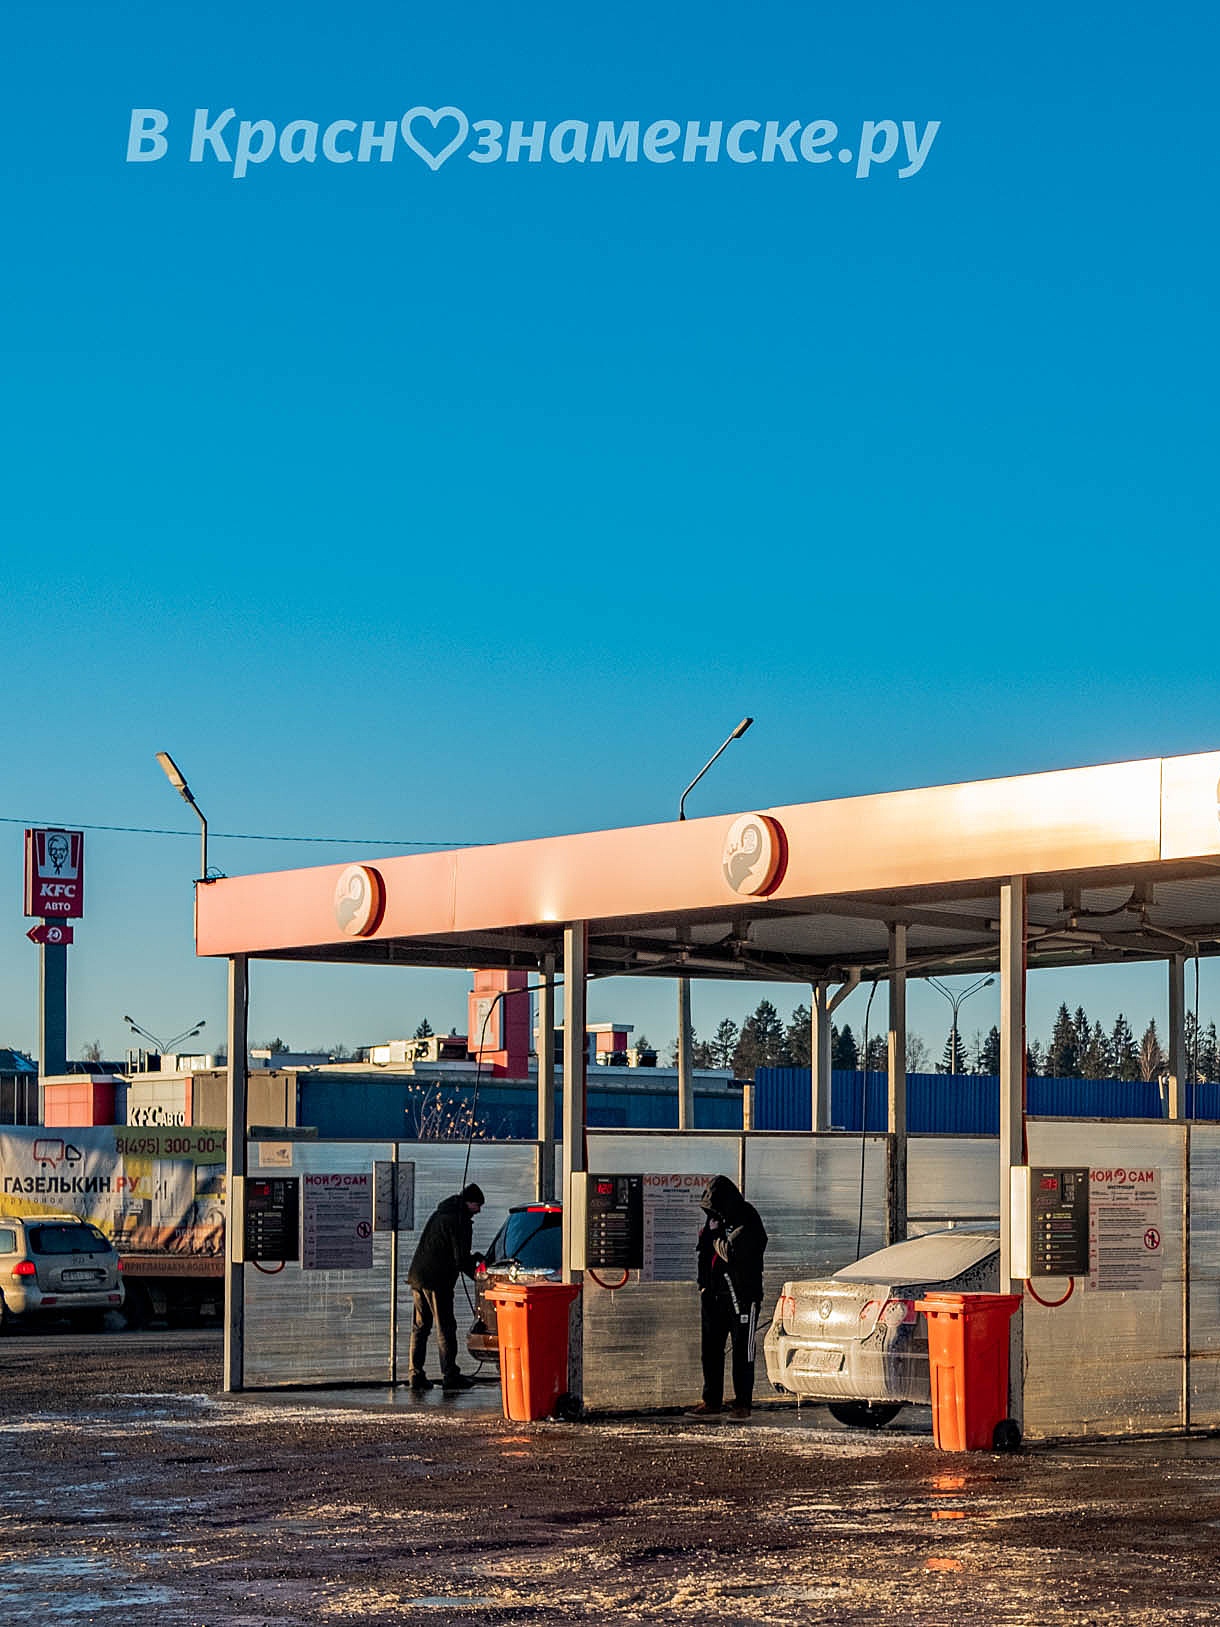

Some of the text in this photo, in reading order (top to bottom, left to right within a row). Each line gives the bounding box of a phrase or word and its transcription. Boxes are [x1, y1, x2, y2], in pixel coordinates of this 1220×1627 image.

[40, 883, 77, 898] KFC
[45, 902, 71, 911] АВТО
[126, 1107, 163, 1127] KFC
[161, 1111, 186, 1127] АВТО
[115, 1137, 159, 1155] 8(495)
[4, 1176, 139, 1193] ГАЗЕЛЬКИН.РУ
[1128, 1171, 1154, 1182] САМ
